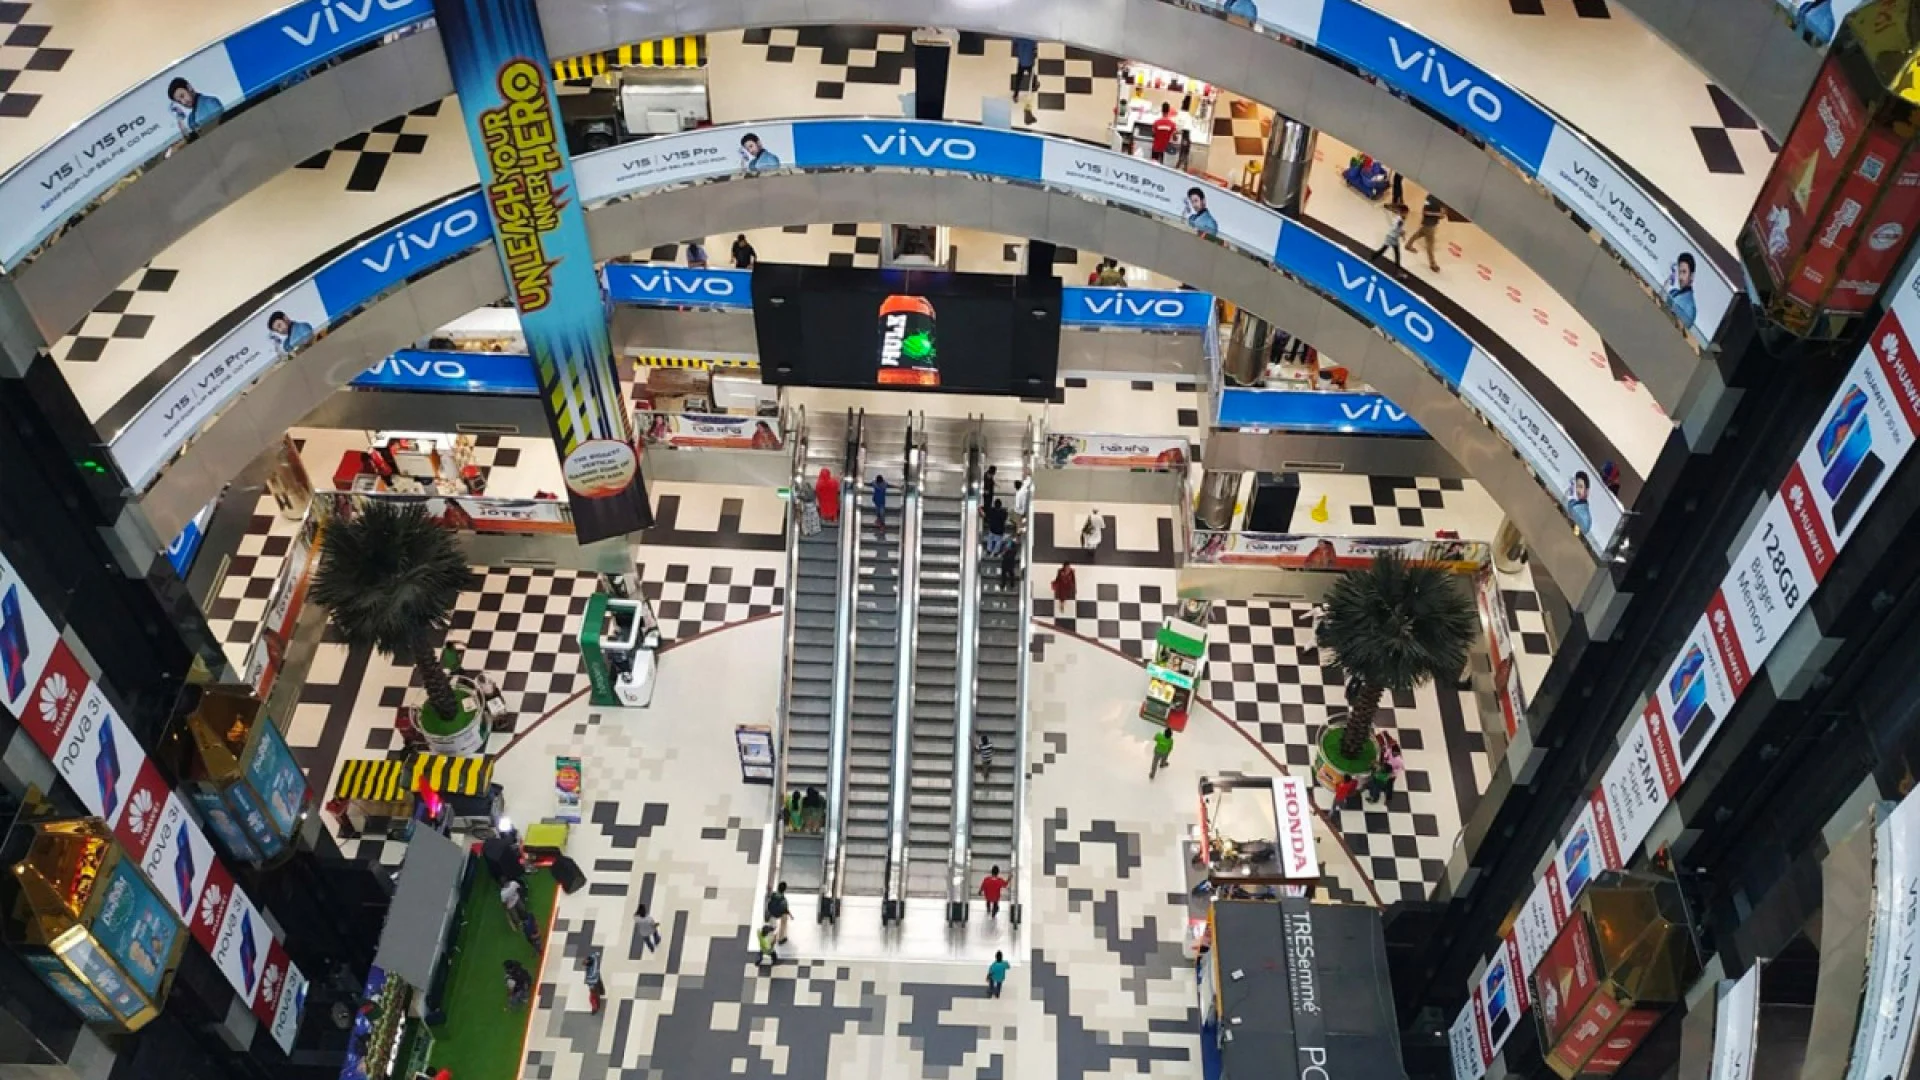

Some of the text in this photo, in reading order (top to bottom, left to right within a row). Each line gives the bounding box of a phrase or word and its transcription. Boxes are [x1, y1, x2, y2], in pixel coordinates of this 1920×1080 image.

[1387, 36, 1502, 123] vivo
[40, 114, 146, 190] V15 V15 Pro
[622, 155, 651, 171] V15
[662, 149, 692, 163] V15
[692, 145, 718, 156] Pro
[863, 130, 976, 160] vivo
[1075, 160, 1165, 192] V15 V15 Pro
[1572, 161, 1657, 243] V15 V15 Pro
[362, 208, 478, 273] vivo
[630, 268, 735, 297] vivo
[1085, 292, 1184, 317] vivo
[1336, 262, 1434, 342] vivo
[163, 345, 250, 421] V15 V15 Pro
[1489, 379, 1559, 459] V15 V15 Pro
[1762, 522, 1799, 609] 128GB
[1800, 509, 1824, 563] HUAWEI
[1737, 569, 1767, 644] Memory
[1752, 557, 1775, 613] Bigger
[53, 689, 78, 736] HUAWEI
[60, 714, 92, 774] nova
[1634, 733, 1659, 803] 32MP
[1628, 761, 1644, 807] Super
[140, 802, 160, 845] HUAWEI
[147, 806, 179, 880] nova 3i
[1283, 781, 1308, 872] HONDA
[217, 914, 237, 965] nova
[1292, 912, 1321, 1013] TRESemmé
[276, 989, 291, 1037] nova
